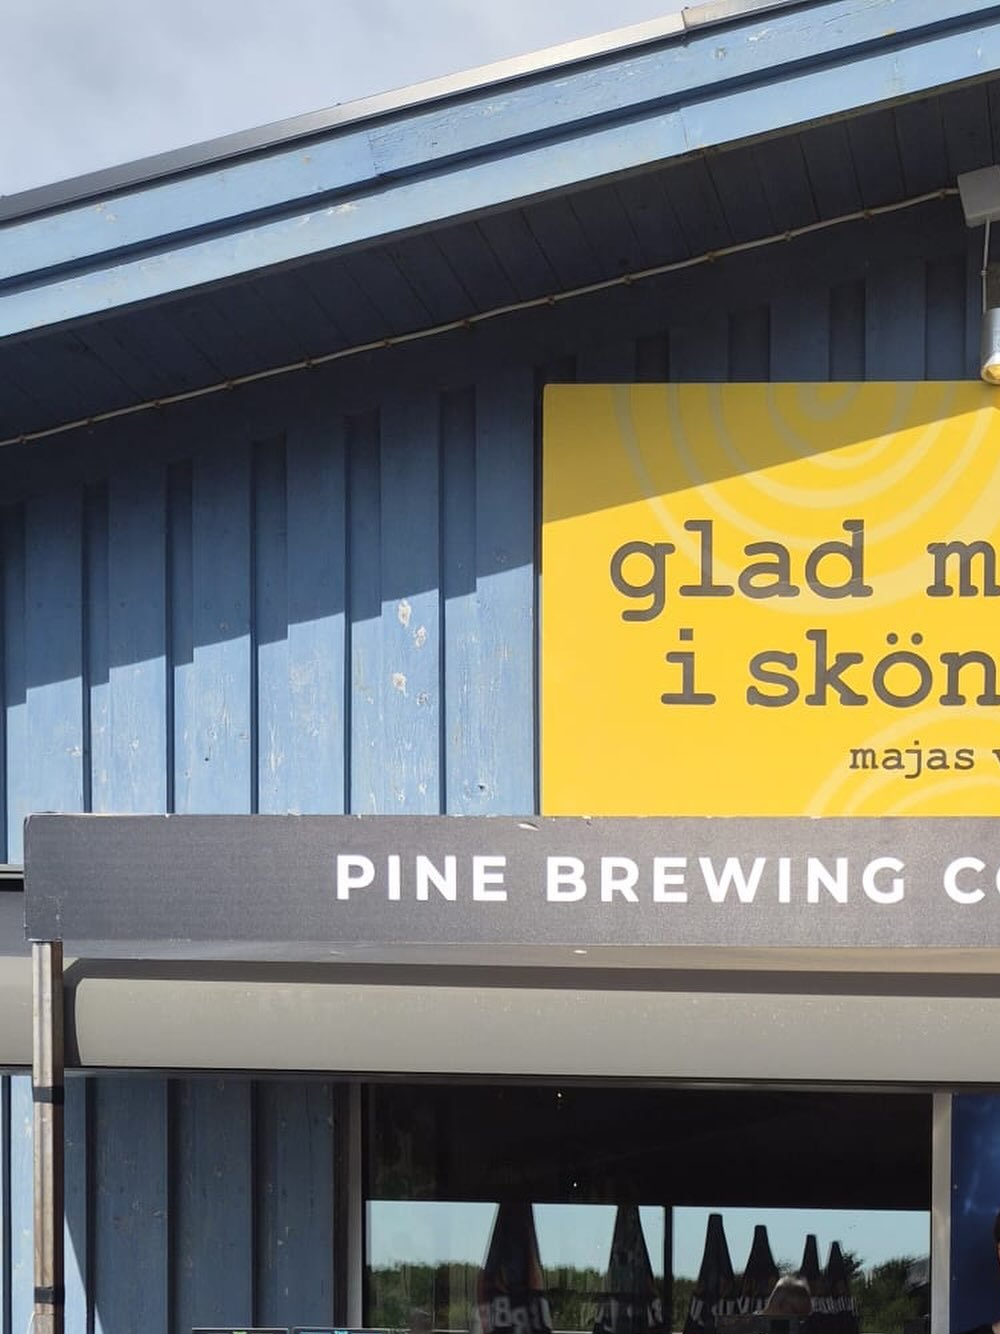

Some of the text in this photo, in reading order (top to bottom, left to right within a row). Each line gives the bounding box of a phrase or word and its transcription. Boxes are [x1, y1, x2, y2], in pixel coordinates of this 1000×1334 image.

[609, 518, 872, 623] glad
[660, 627, 716, 706] i
[849, 741, 975, 779] majas
[336, 854, 508, 901] PINE
[546, 855, 906, 905] BREWING
